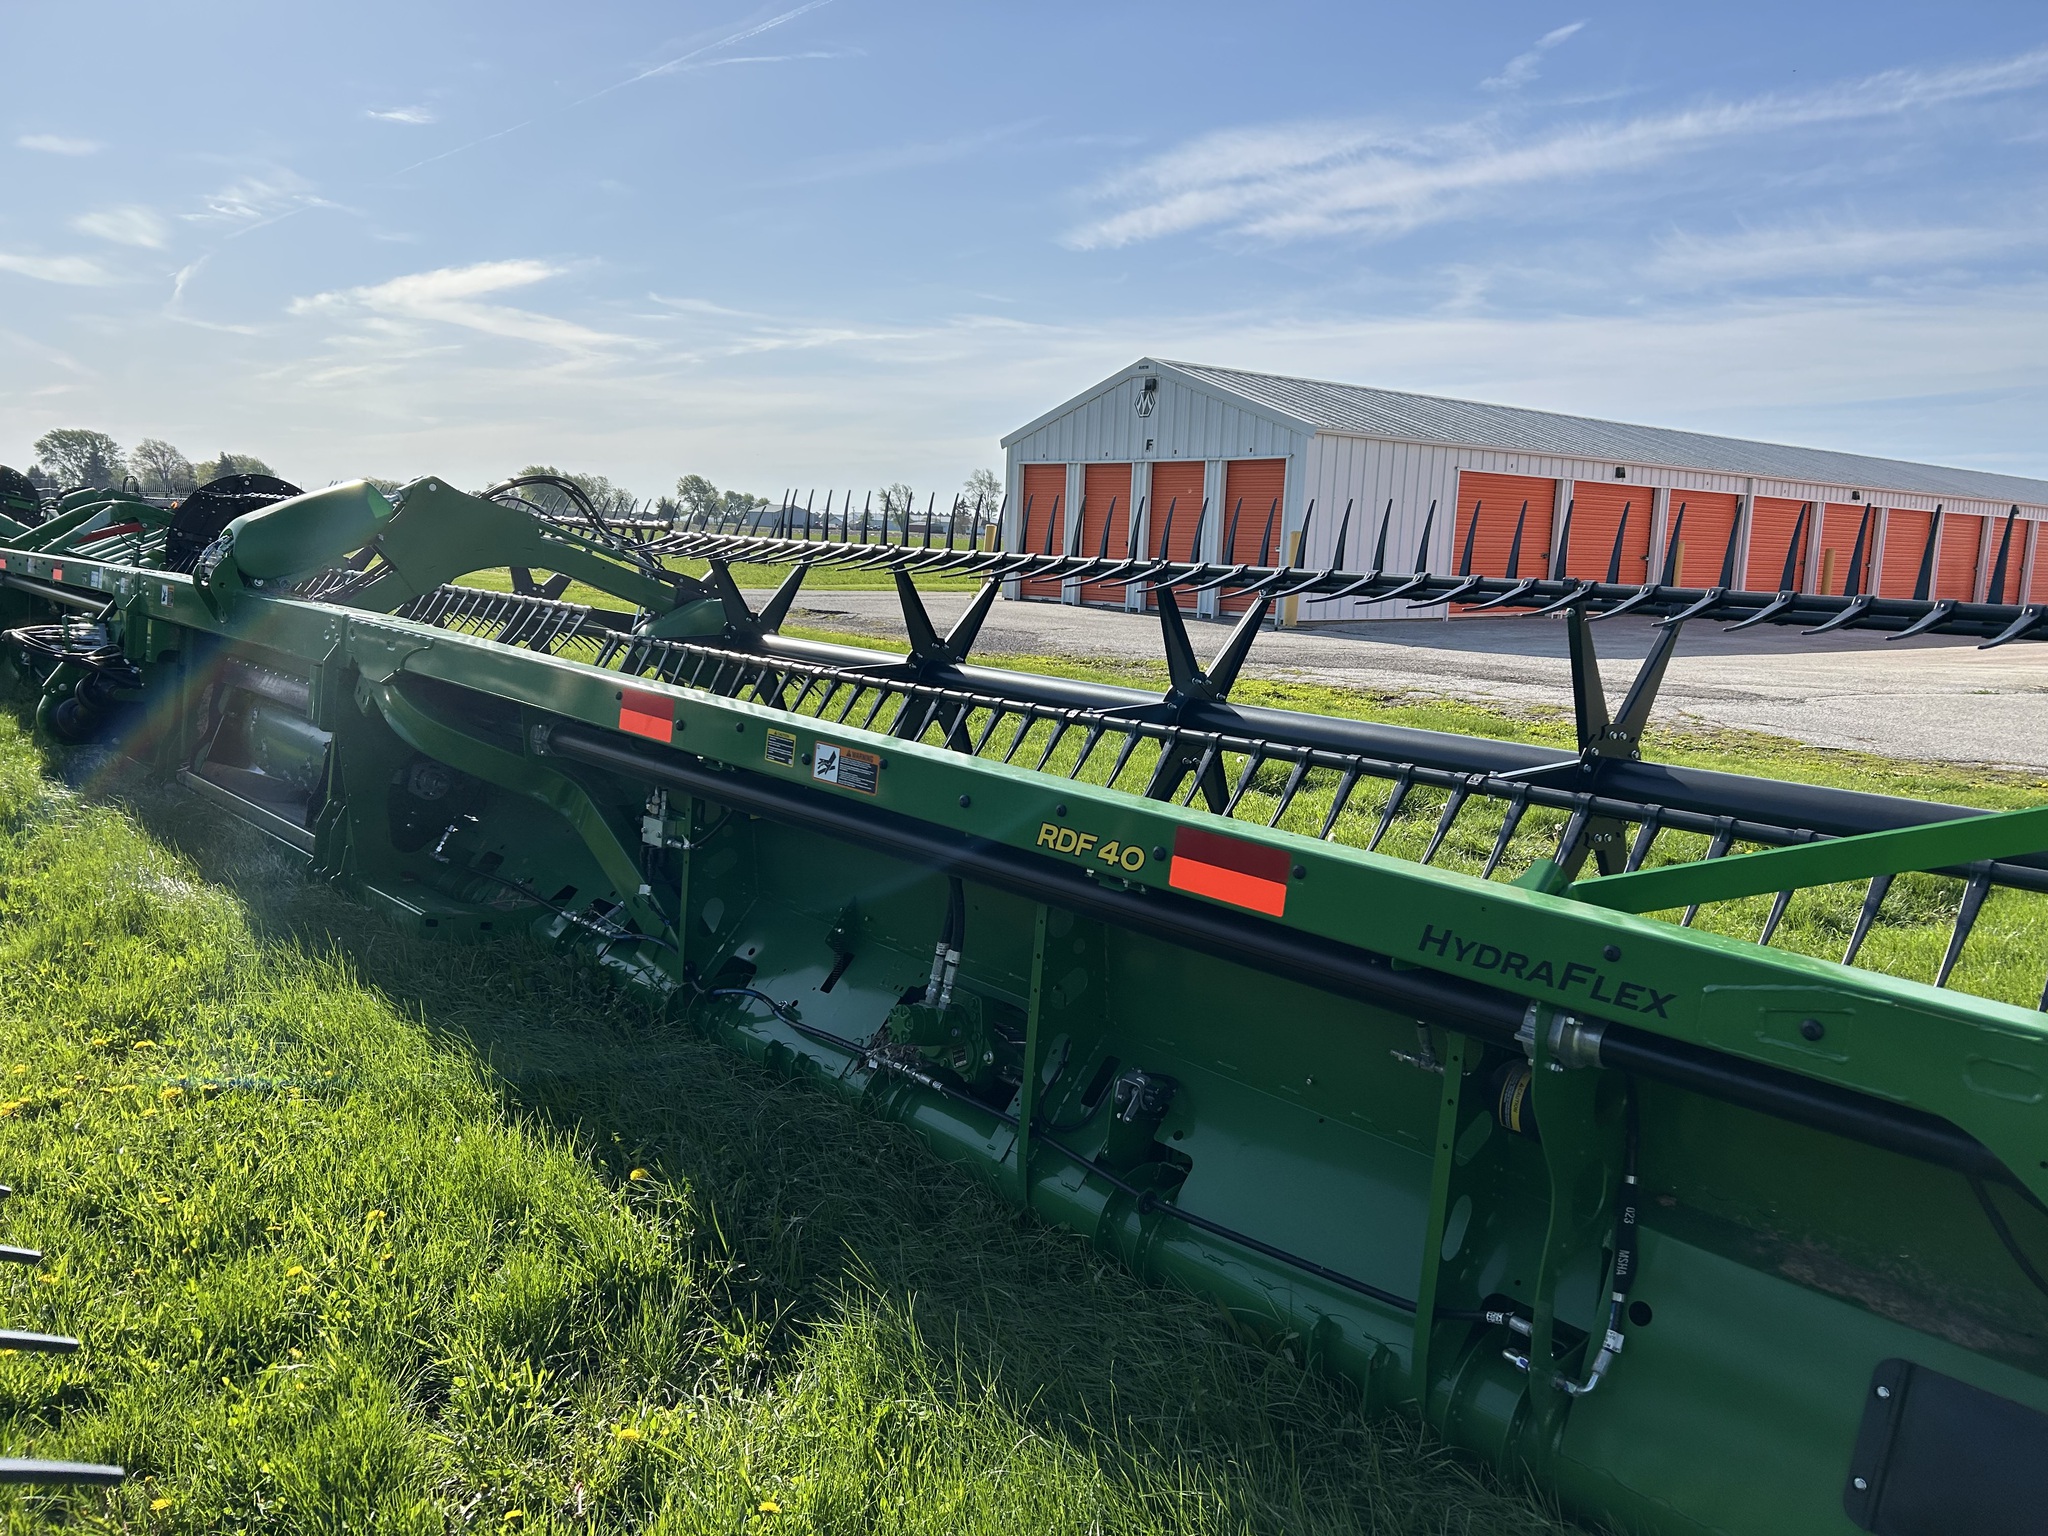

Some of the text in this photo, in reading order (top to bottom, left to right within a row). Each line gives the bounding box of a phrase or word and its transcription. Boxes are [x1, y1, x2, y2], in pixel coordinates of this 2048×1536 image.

[1146, 439, 1154, 451] F
[1036, 822, 1147, 872] RDF 40
[1417, 924, 1678, 1019] HYDRAFLEX
[1616, 1206, 1636, 1276] 023 MSHA
